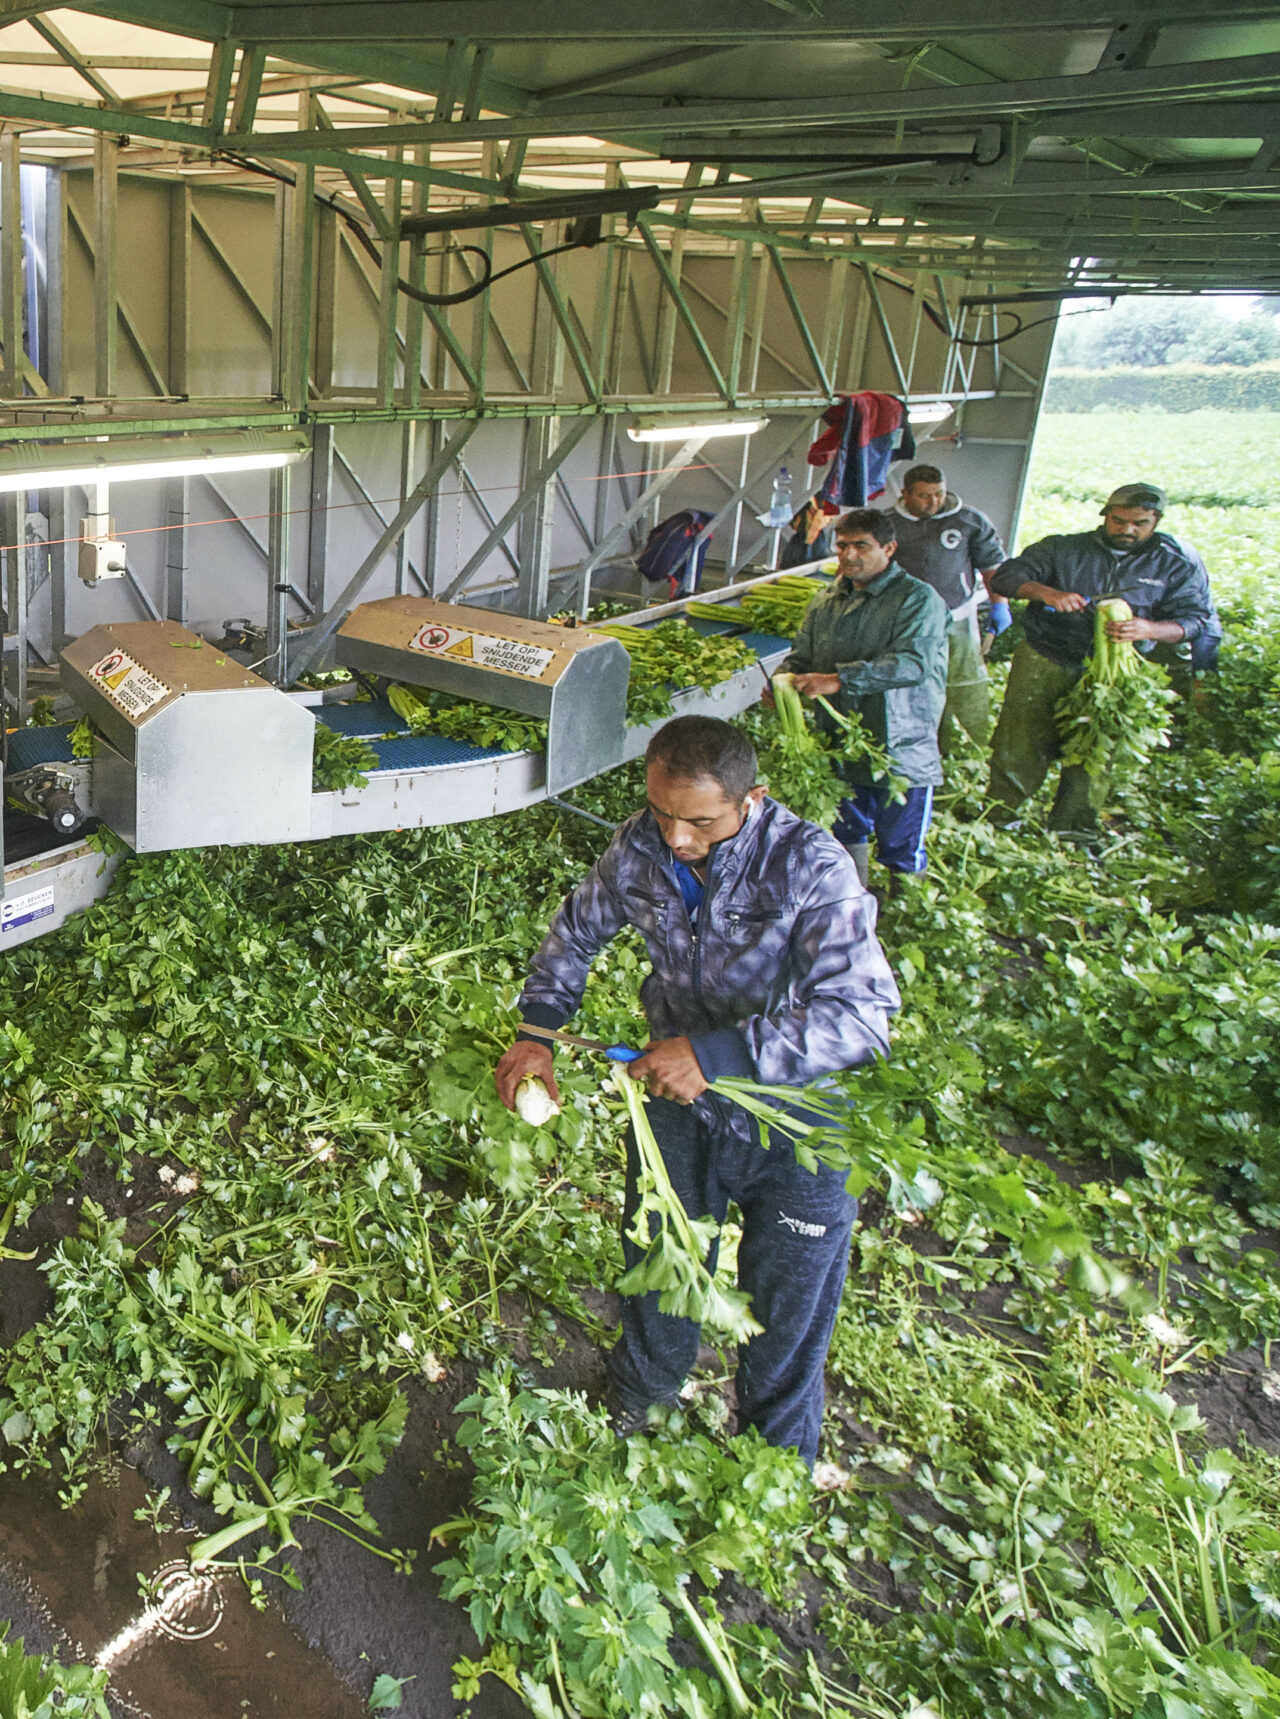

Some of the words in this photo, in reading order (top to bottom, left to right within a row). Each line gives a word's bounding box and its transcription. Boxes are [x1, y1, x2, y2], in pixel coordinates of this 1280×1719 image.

[481, 647, 544, 666] SNIJDENDE
[496, 641, 518, 650] LET
[519, 646, 540, 656] OP!
[483, 656, 531, 672] MESSEN
[138, 675, 151, 686] LET
[117, 690, 140, 710] MESSEN
[124, 680, 154, 705] SNIJDENDE
